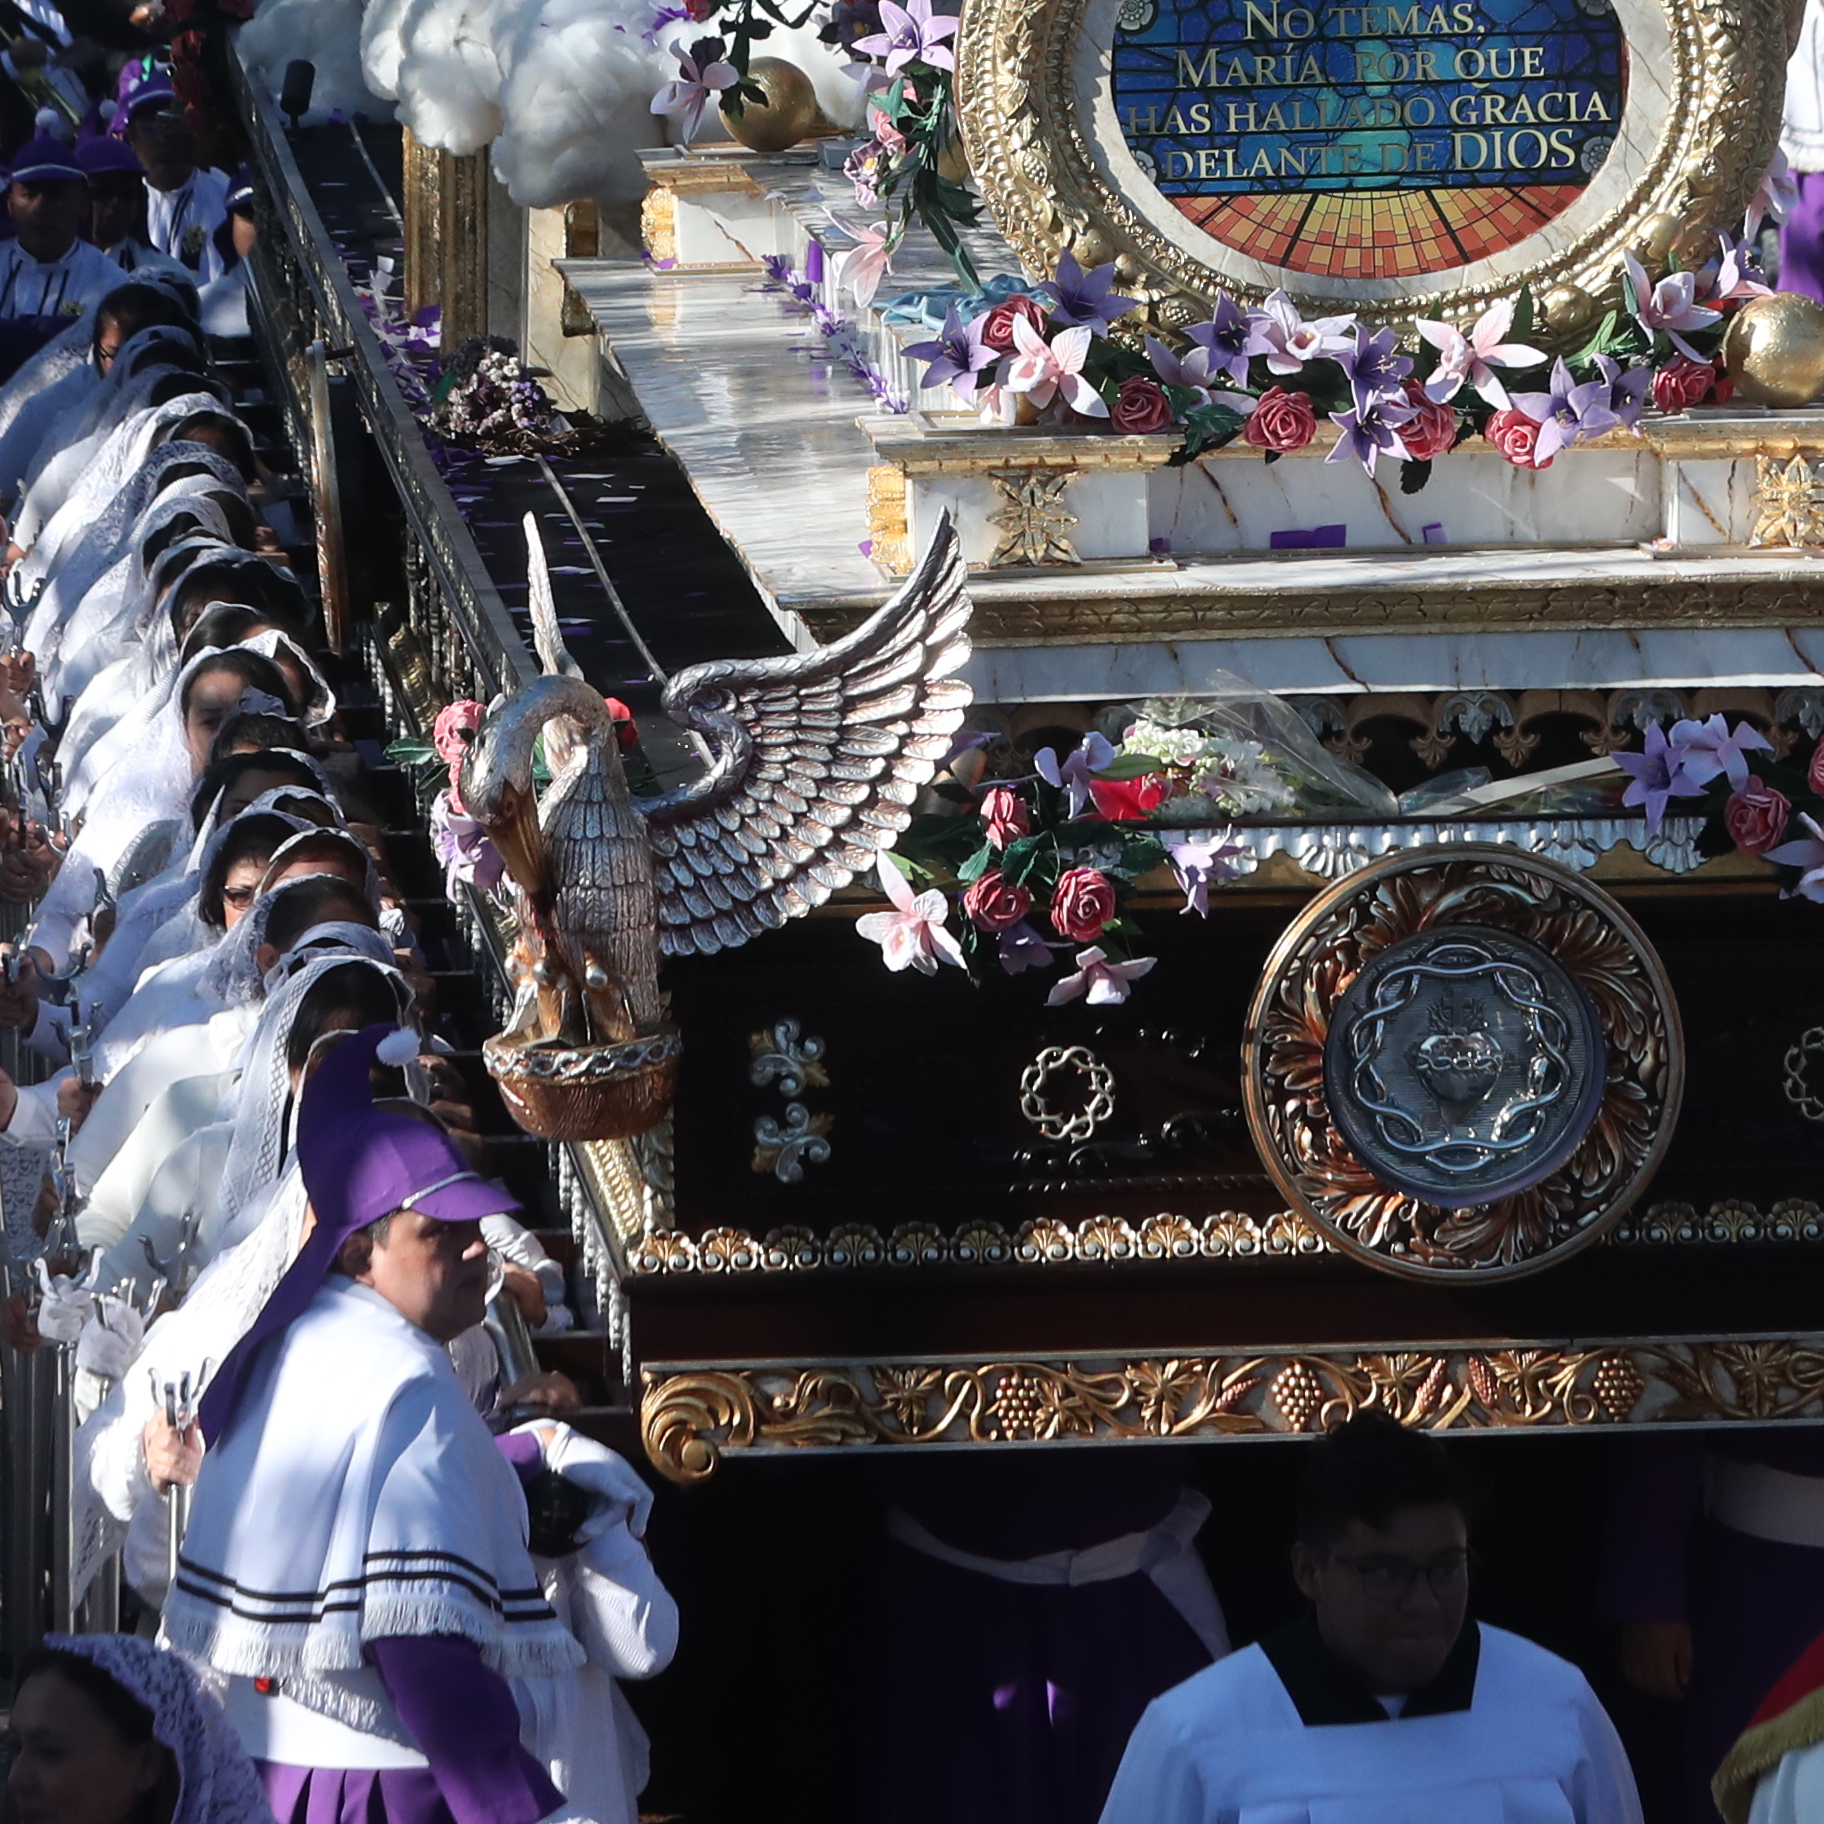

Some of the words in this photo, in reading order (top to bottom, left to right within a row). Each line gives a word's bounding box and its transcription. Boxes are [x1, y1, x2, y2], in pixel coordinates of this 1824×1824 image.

[1353, 50, 1440, 82] POR
[1453, 46, 1545, 87] QUE
[1127, 104, 1211, 137] HAS
[1226, 98, 1434, 133] HALLADO
[1449, 91, 1611, 126] GRACIA
[1163, 144, 1364, 181] DELANTE
[1380, 143, 1436, 174] DE
[1452, 128, 1576, 172] DIOS
